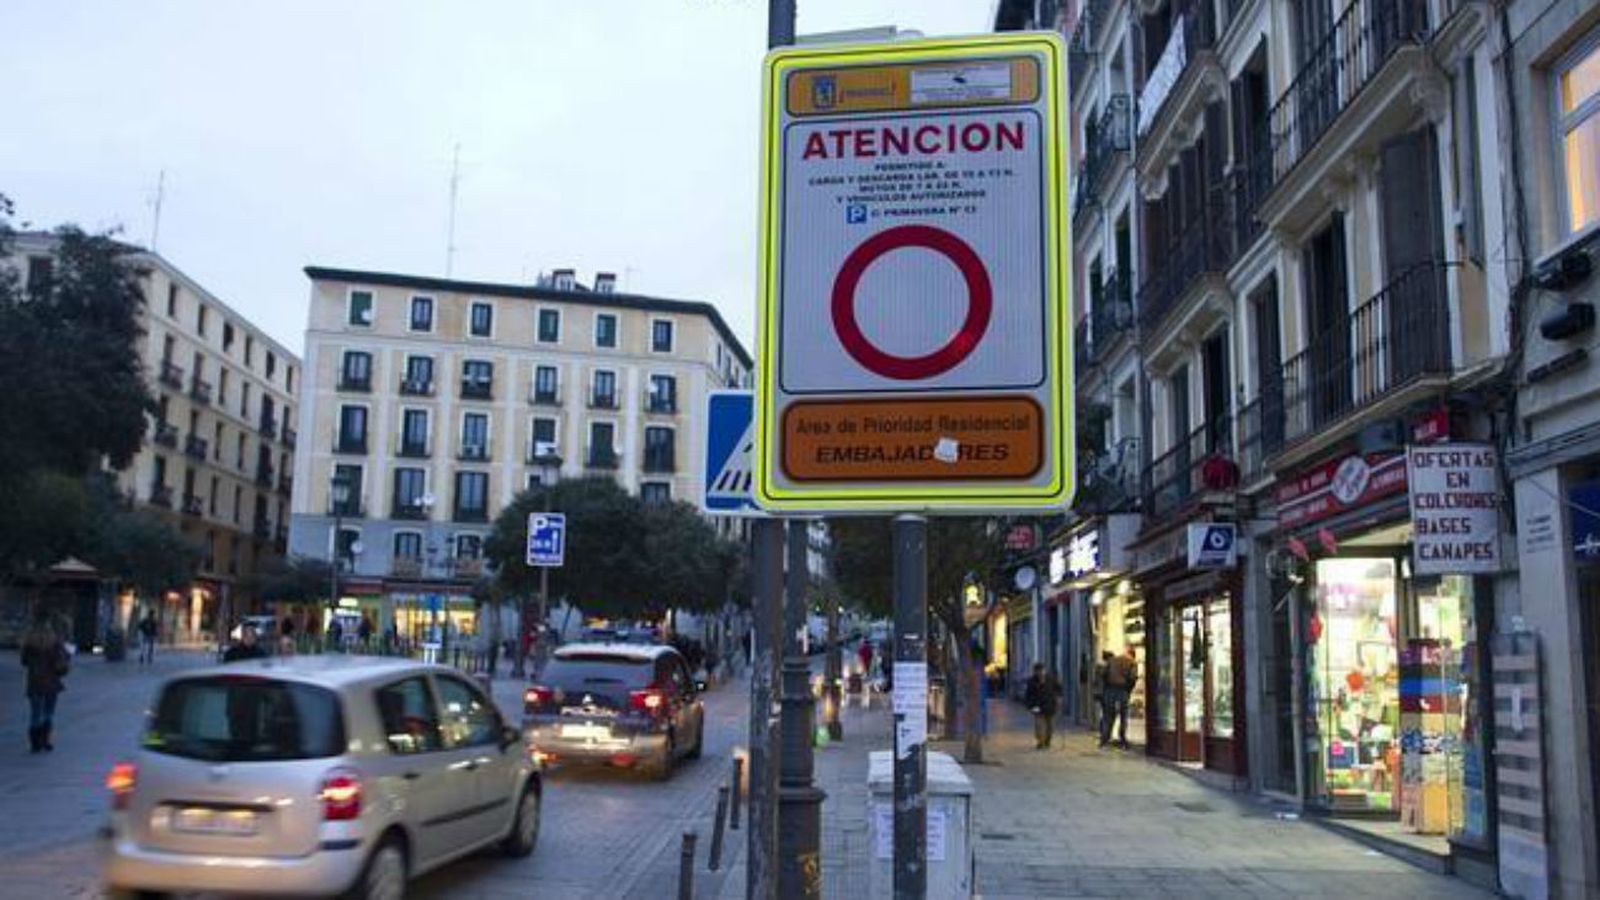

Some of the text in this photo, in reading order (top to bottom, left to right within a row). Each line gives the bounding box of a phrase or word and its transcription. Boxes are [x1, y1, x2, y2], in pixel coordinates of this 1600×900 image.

[802, 121, 1025, 160] ATENCION
[808, 176, 844, 186] CARGA
[857, 172, 914, 183] DESCARGA
[859, 183, 896, 193] MOTOS
[846, 193, 907, 203] VEHICULOS
[910, 190, 986, 200] AUTORIZADOS
[883, 206, 946, 217] PRIMAVERA
[838, 417, 857, 433] de
[864, 415, 933, 433] Prioridad
[939, 413, 1030, 432] Residencial
[815, 443, 1010, 465] EMBAJADRES
[1414, 452, 1494, 468] OFERTAS
[1446, 471, 1470, 487] EN
[1415, 492, 1497, 509] COLCHONES
[1418, 517, 1471, 534] BASES
[1419, 542, 1493, 561] CANAPES
